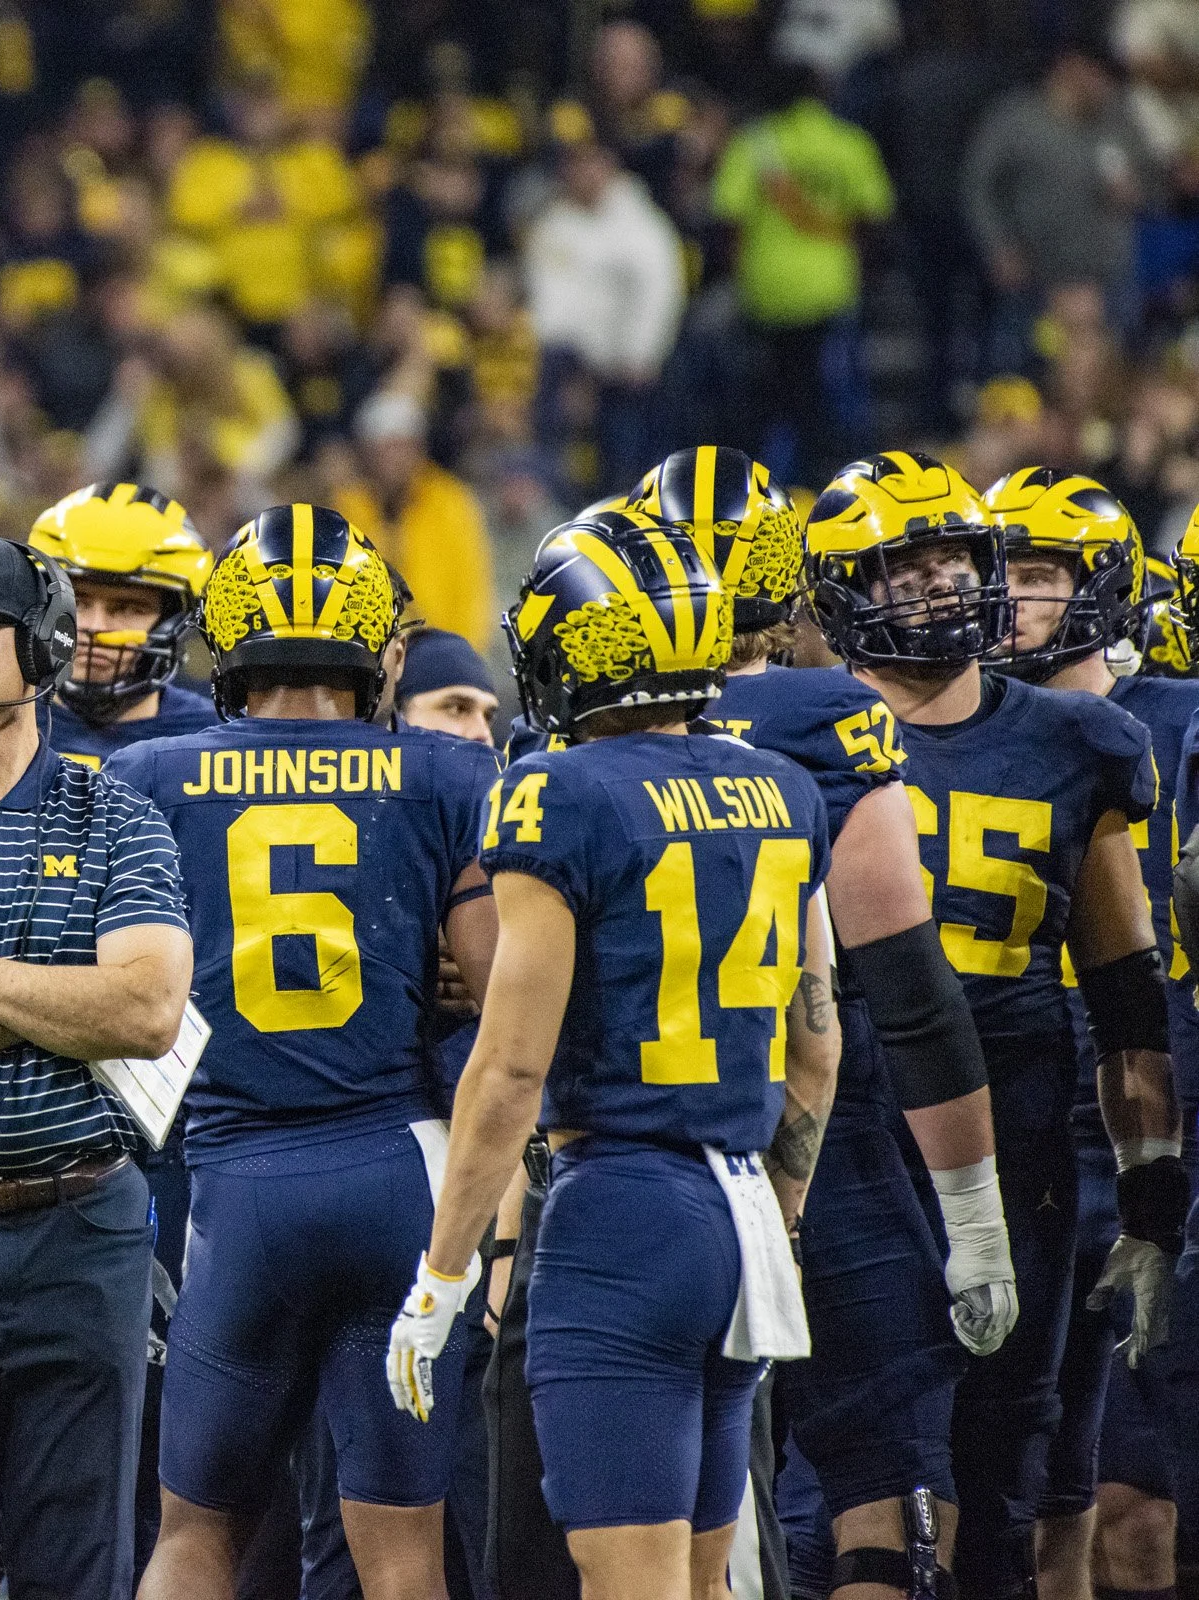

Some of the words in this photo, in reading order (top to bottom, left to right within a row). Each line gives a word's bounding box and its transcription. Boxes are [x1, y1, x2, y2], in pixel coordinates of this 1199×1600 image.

[54, 629, 74, 648] meijer
[253, 614, 262, 630] 6
[634, 654, 651, 669] 14
[834, 701, 909, 773] 52
[183, 747, 401, 795] JOHNSON
[483, 772, 548, 850] 14
[642, 776, 792, 832] WILSON
[42, 855, 78, 877] M
[227, 803, 364, 1033] 6
[640, 838, 812, 1085] 14
